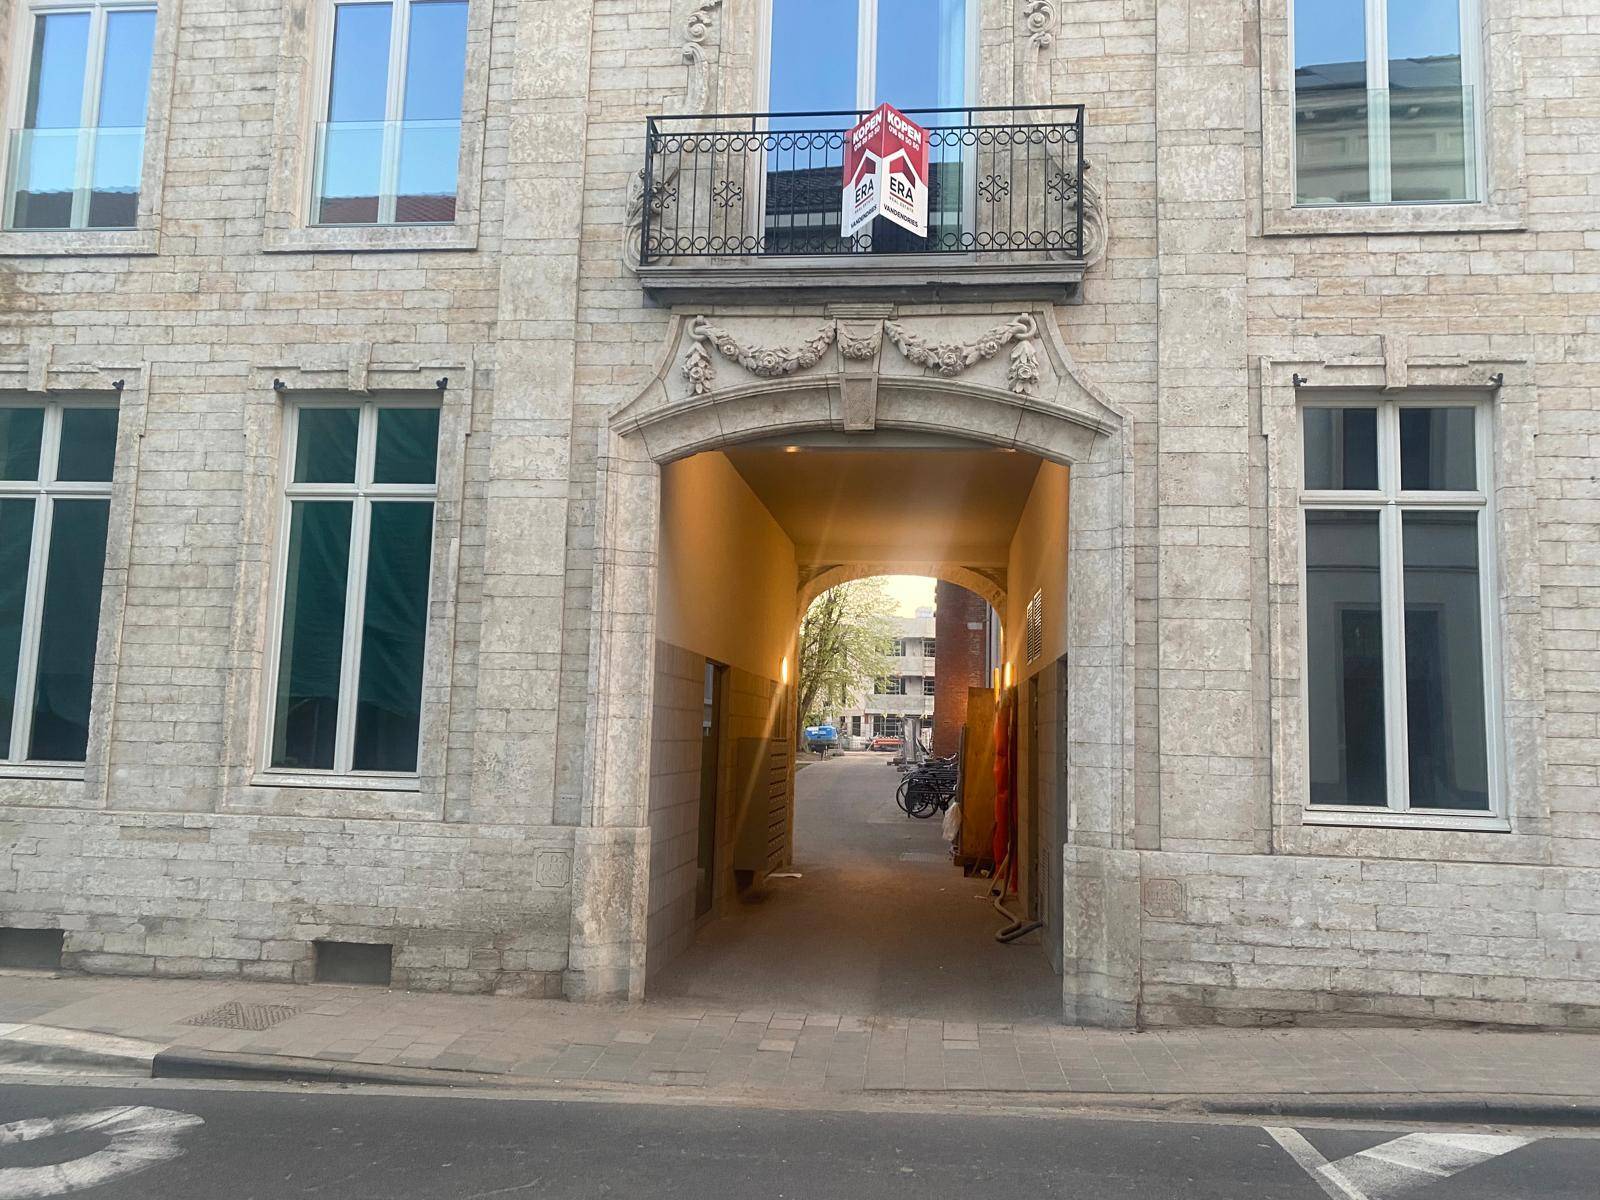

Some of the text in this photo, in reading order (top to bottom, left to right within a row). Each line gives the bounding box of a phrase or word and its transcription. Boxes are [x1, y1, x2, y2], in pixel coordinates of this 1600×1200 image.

[853, 110, 882, 145] KOPEN
[887, 110, 922, 145] KOPEN
[855, 179, 874, 204] ERA
[890, 176, 914, 203] ERA
[883, 203, 919, 228] VANDENDRIES
